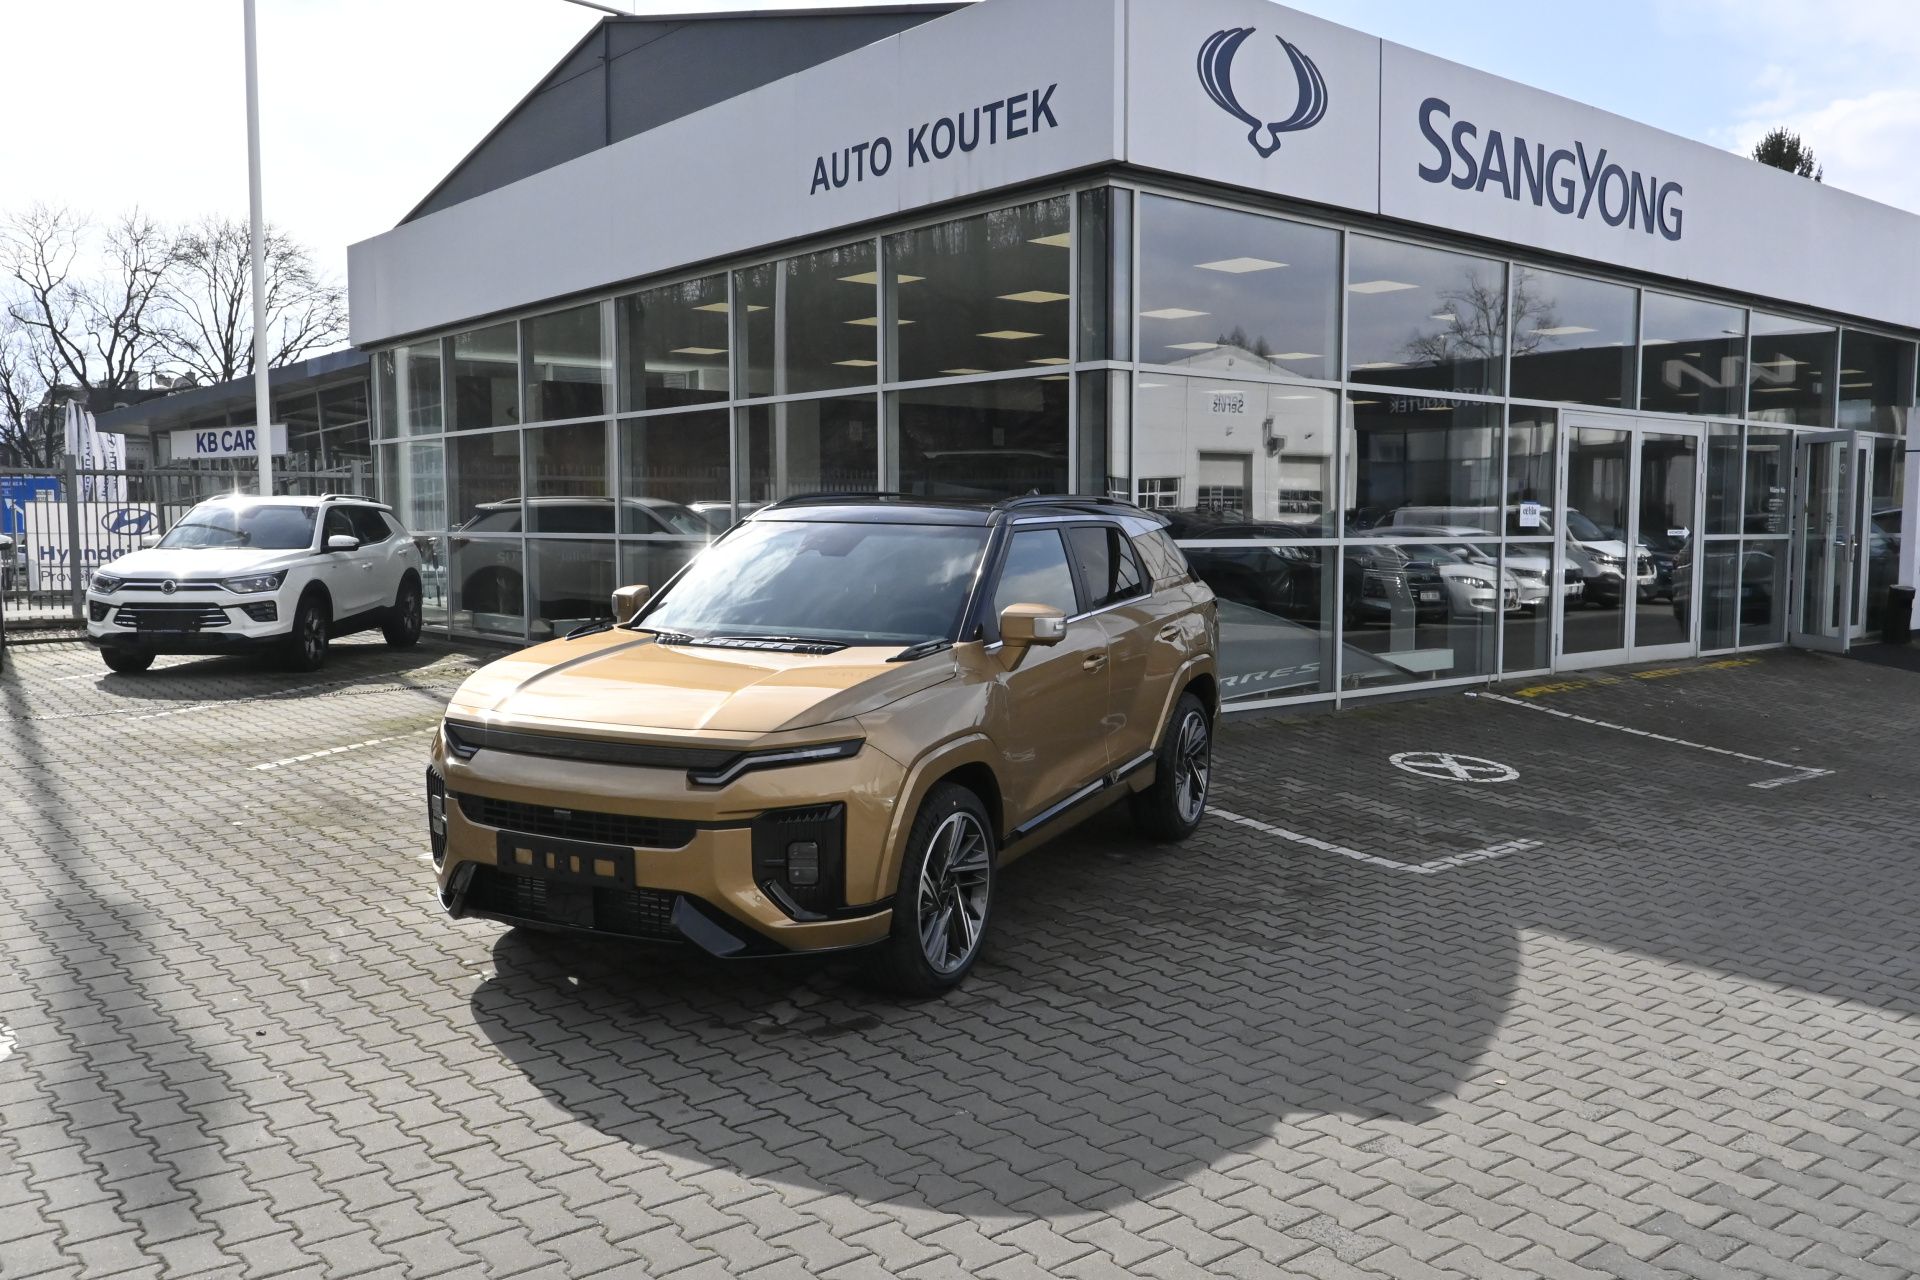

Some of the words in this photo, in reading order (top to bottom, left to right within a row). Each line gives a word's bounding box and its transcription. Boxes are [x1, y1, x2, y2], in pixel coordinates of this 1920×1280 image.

[810, 137, 892, 195] AUTO
[908, 83, 1059, 168] KOUTEK
[196, 432, 219, 453] KB
[221, 430, 257, 452] CAR
